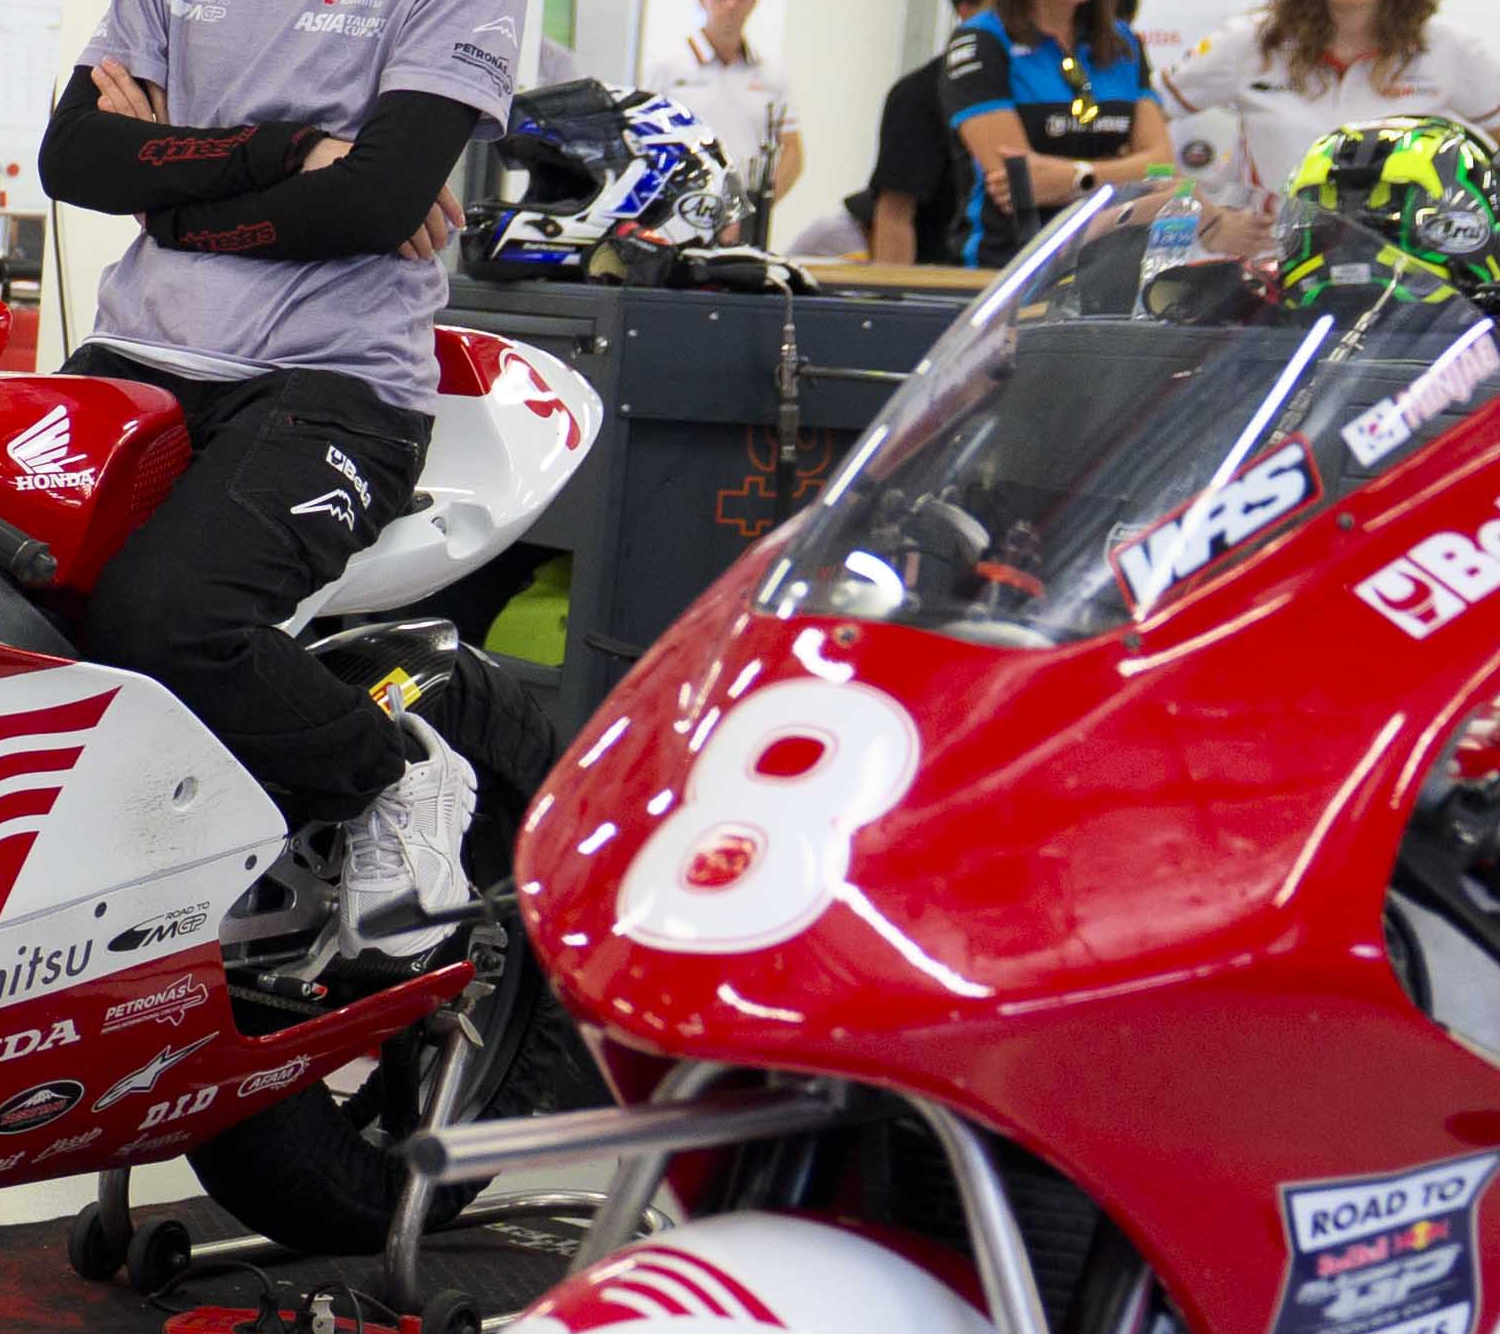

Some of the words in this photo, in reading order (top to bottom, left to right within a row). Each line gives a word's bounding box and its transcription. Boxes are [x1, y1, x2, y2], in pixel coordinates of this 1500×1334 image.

[292, 11, 345, 34] ASIA
[454, 41, 509, 77] PETRONAS
[16, 470, 97, 491] HONDA
[343, 458, 372, 510] Beta
[1112, 444, 1309, 607] WRS
[616, 677, 920, 955] 8
[165, 907, 195, 922] ROAD
[197, 901, 211, 911] TO
[105, 988, 187, 1021] PETRONAS
[1308, 1186, 1408, 1236] ROAD
[1418, 1175, 1466, 1208] TO
